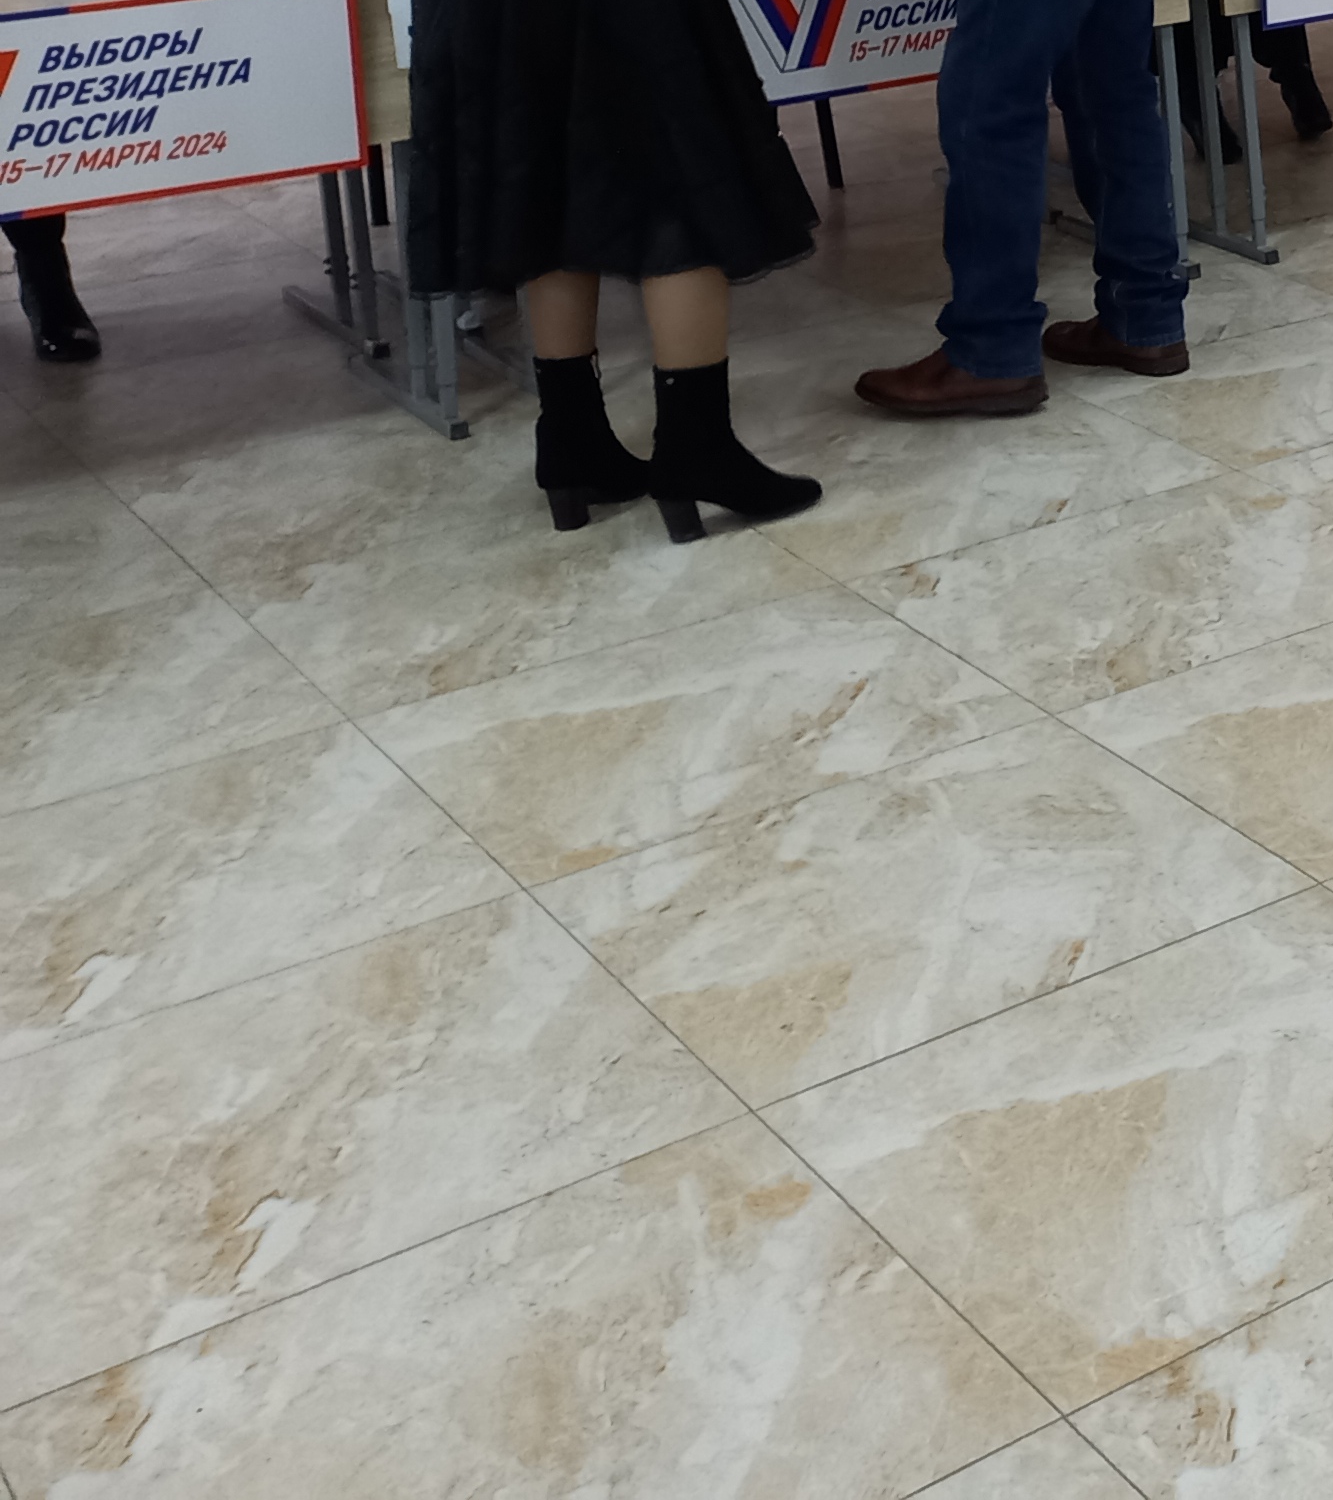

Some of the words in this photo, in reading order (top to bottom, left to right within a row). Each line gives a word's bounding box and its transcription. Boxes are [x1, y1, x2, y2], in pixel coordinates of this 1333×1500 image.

[38, 26, 203, 74] ВЫБОРЫ
[23, 57, 251, 113] ПРЕЗИДЕНТА
[8, 105, 159, 151] РОССИИ
[74, 140, 161, 176] МАРТА
[167, 130, 227, 160] 2024
